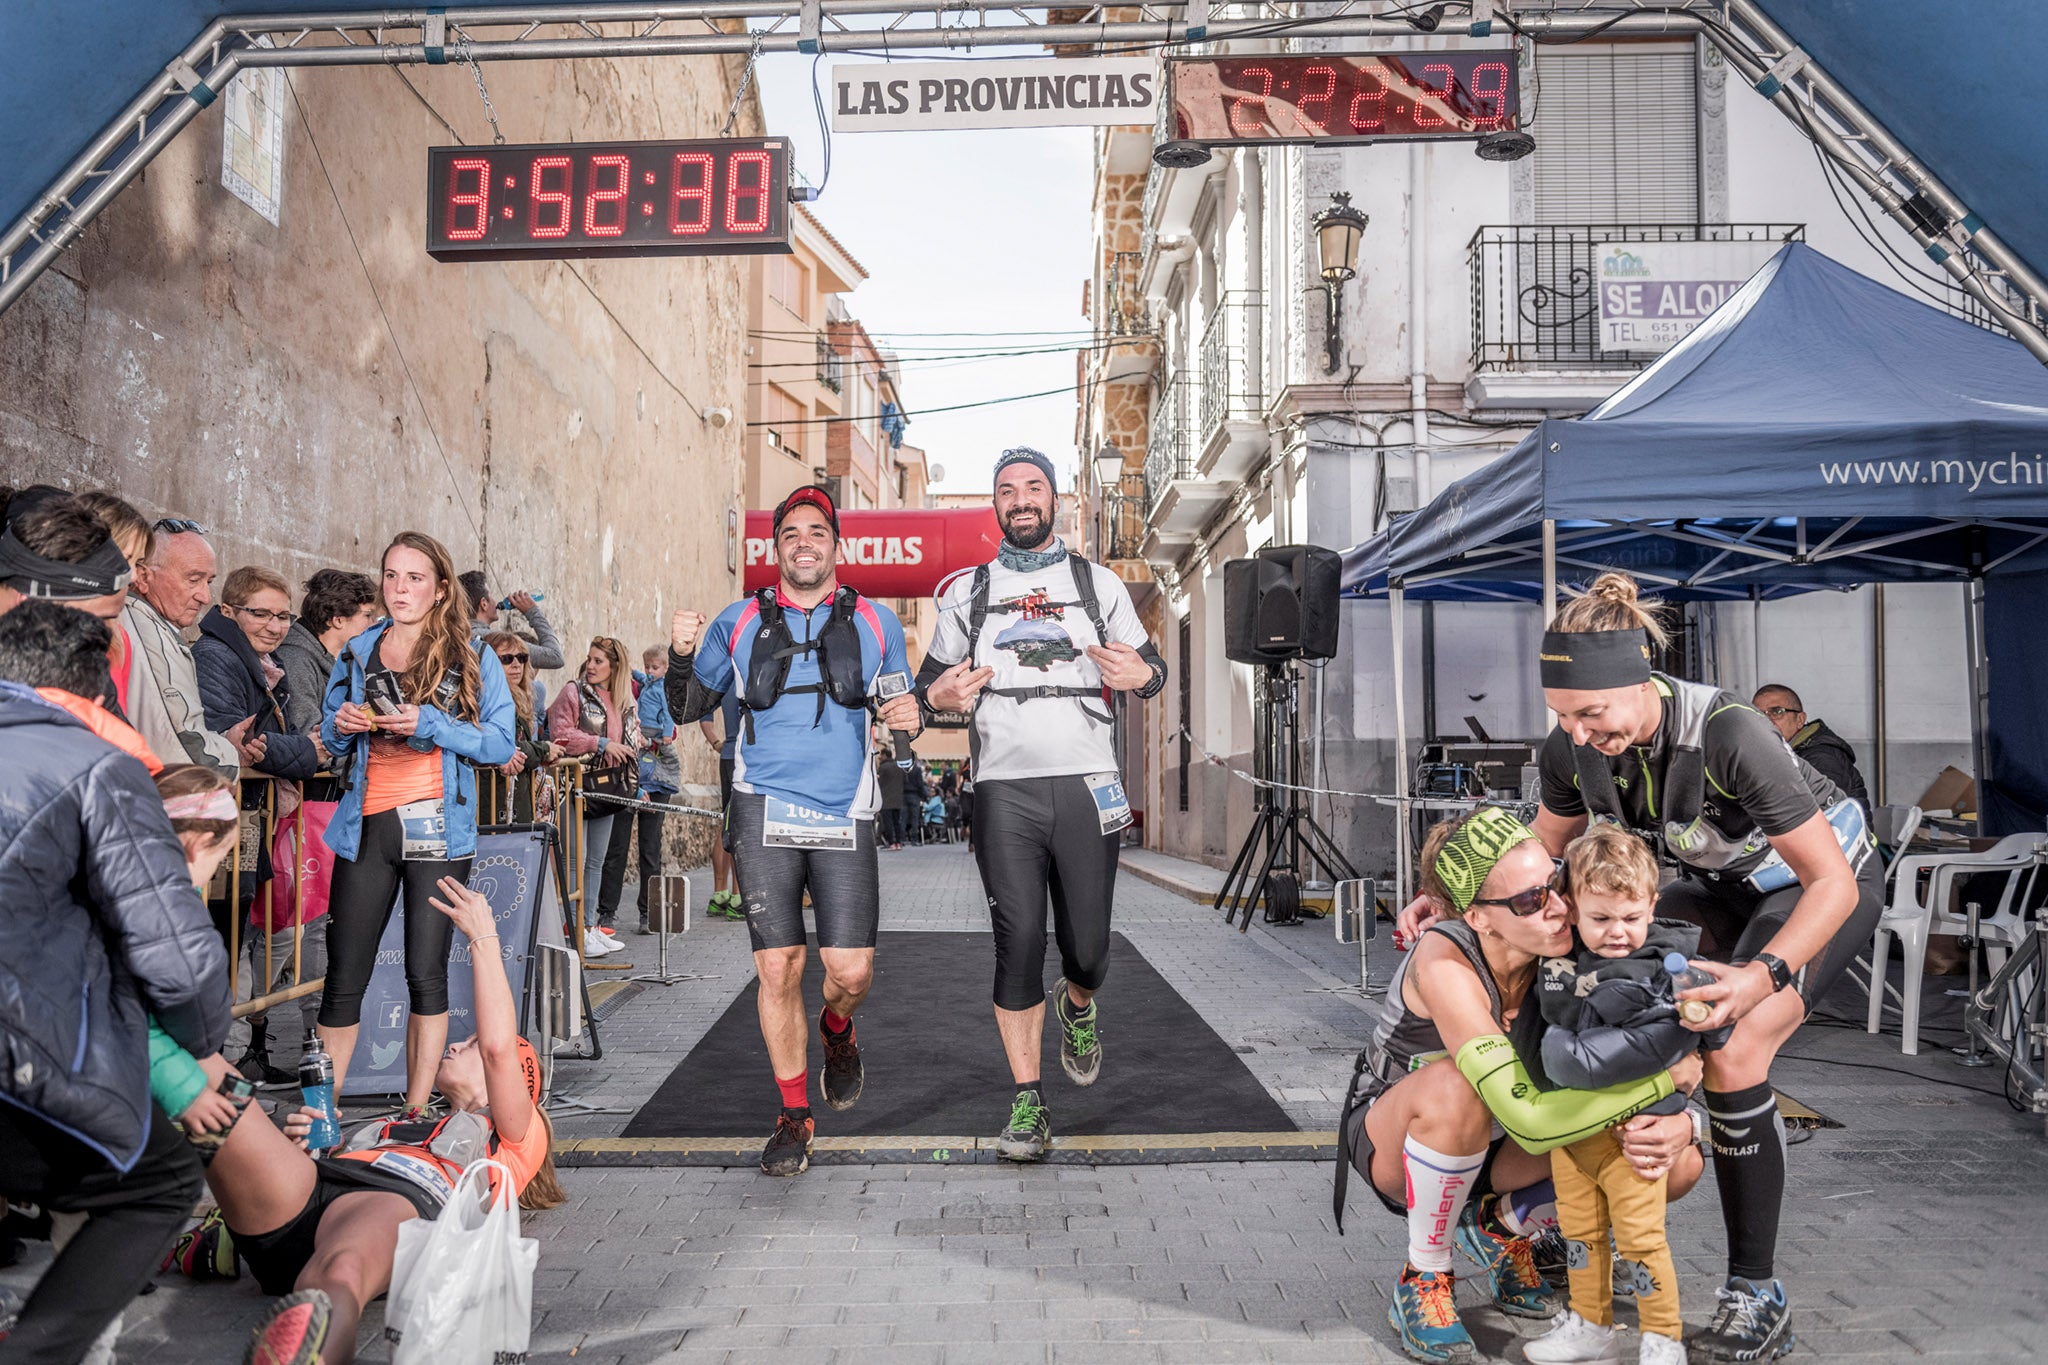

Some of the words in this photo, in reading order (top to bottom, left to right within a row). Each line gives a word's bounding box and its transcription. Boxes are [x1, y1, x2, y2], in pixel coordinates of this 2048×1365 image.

[838, 80, 909, 115] LAS
[919, 73, 1153, 113] PROVINCIAS
[1231, 62, 1508, 131] 2:22:29
[448, 151, 771, 240] 3:52:30
[1607, 284, 1643, 316] SE
[1652, 323, 1679, 332] 651
[1820, 452, 2048, 493] www.mychi
[745, 536, 922, 566] PNCIAS
